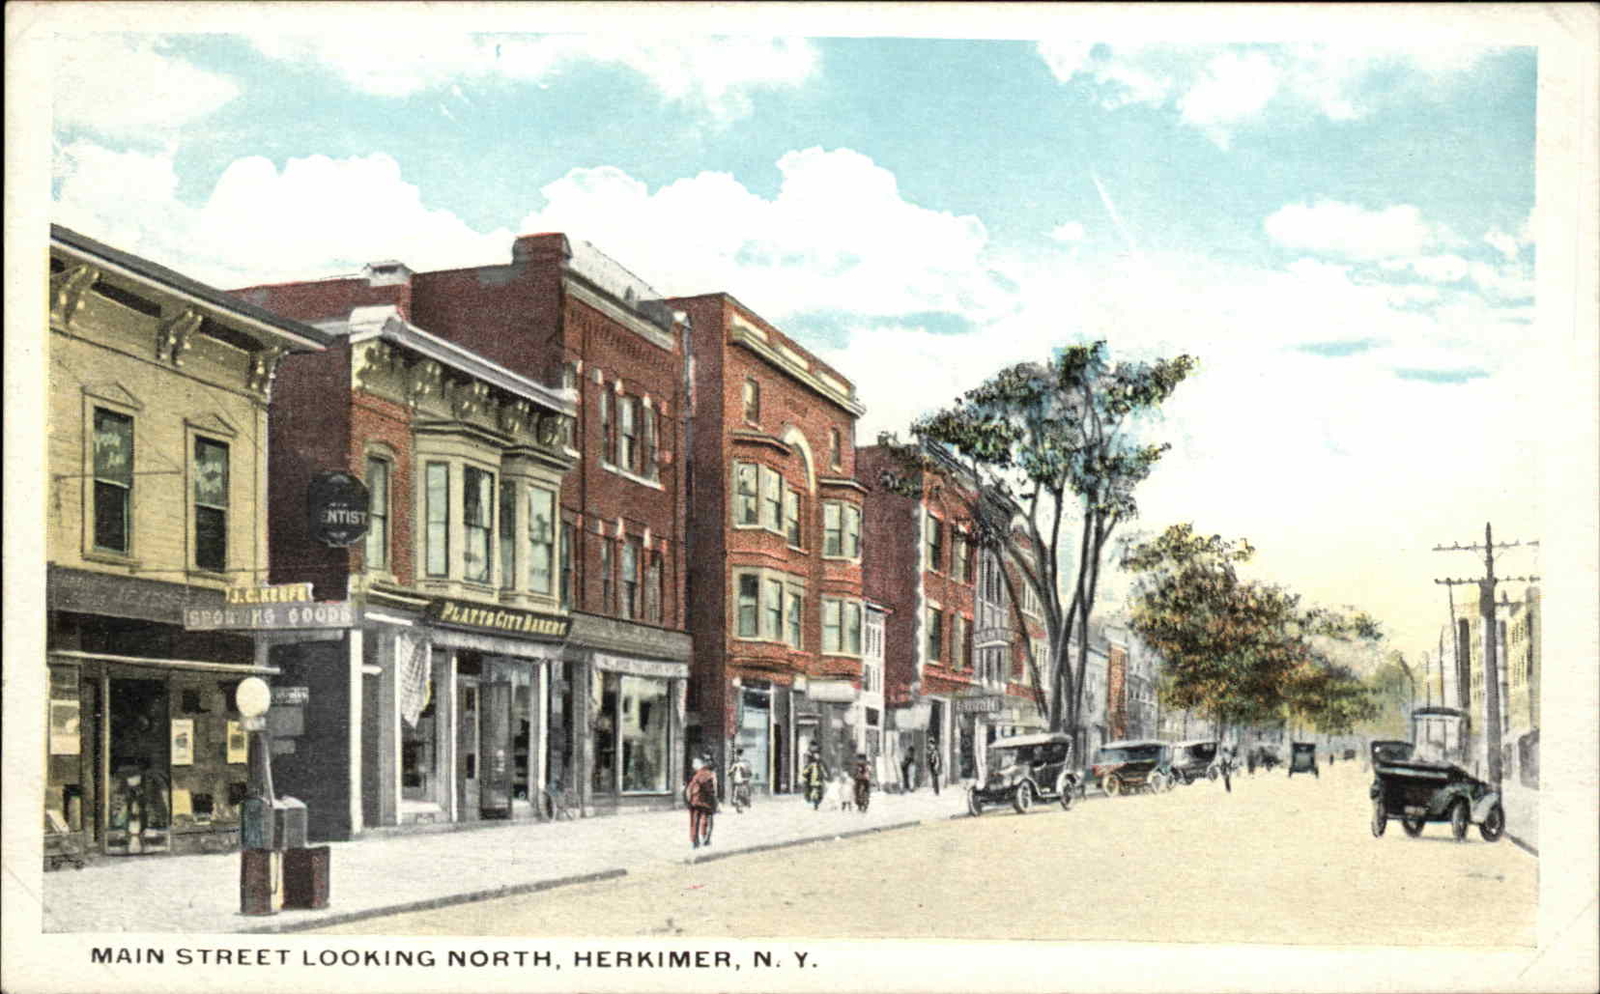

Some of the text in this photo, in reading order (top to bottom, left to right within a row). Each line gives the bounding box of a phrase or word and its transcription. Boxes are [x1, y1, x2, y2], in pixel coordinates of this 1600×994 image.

[319, 509, 367, 525] ENTIST
[288, 605, 352, 627] GOODS
[495, 609, 525, 632] CITY
[523, 613, 568, 636] BAKERY
